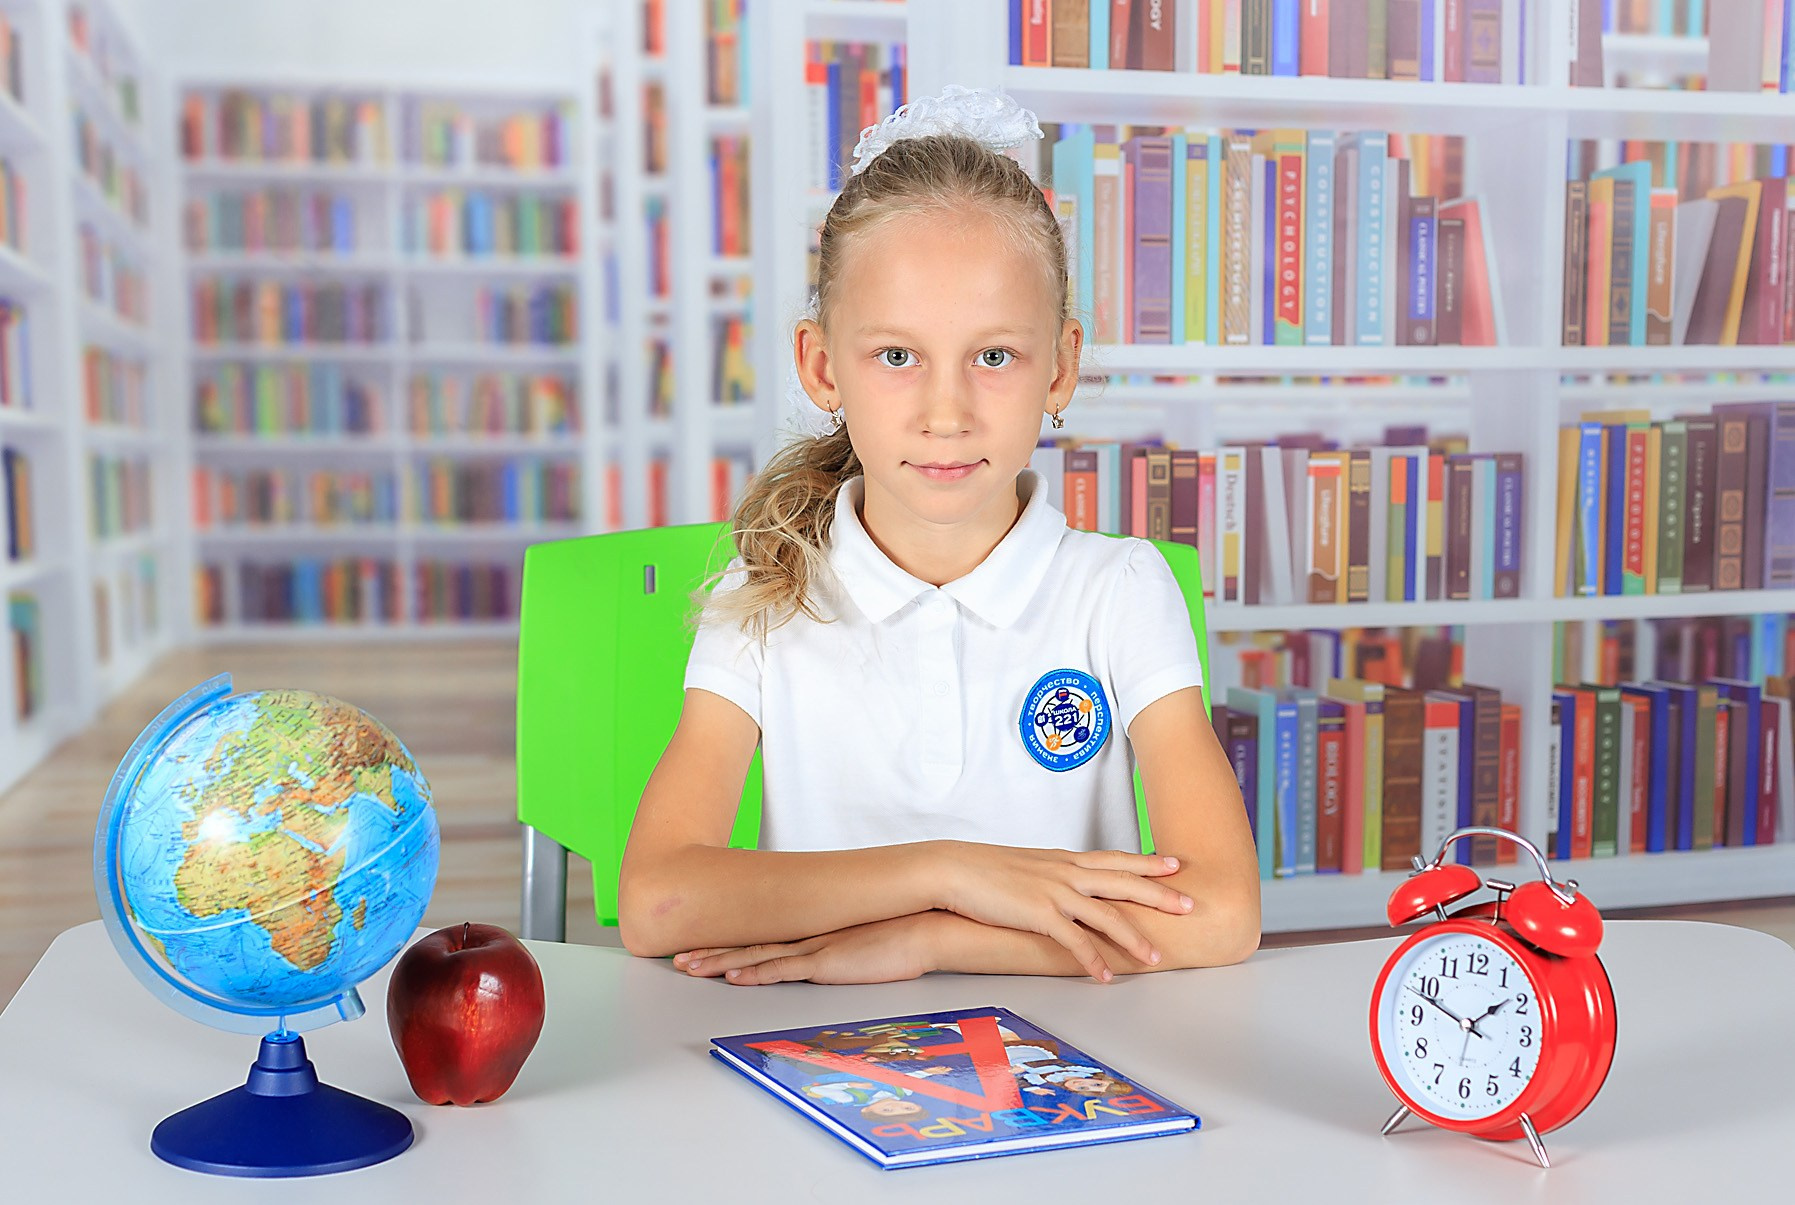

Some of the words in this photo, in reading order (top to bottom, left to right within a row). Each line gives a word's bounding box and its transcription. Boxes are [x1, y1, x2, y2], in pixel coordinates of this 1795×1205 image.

[1232, 177, 1246, 305] ARCHITECTURE
[1283, 170, 1297, 309] PSYCHOLOGY
[1315, 165, 1329, 322] CONSTRUCTION
[1368, 165, 1381, 322] CONSTRUCTION
[1226, 474, 1238, 530] Deutsch
[1630, 444, 1643, 563] PSYCHOLOGY
[1054, 712, 1078, 727] 221
[1436, 734, 1448, 843] STATISTIC
[1439, 956, 1459, 979] 11
[1466, 952, 1489, 976] 12
[1418, 975, 1440, 998] 10
[1498, 967, 1508, 988] 1
[1411, 1005, 1424, 1026] 9
[1516, 993, 1528, 1015] 2
[1415, 1037, 1428, 1059] 8
[1519, 1026, 1532, 1047] 3
[1433, 1063, 1444, 1085] 7
[1509, 1057, 1522, 1078] 4
[1458, 1077, 1471, 1099] 6
[1486, 1075, 1499, 1096] 5
[871, 1096, 1165, 1141] БУКВАРЬ
